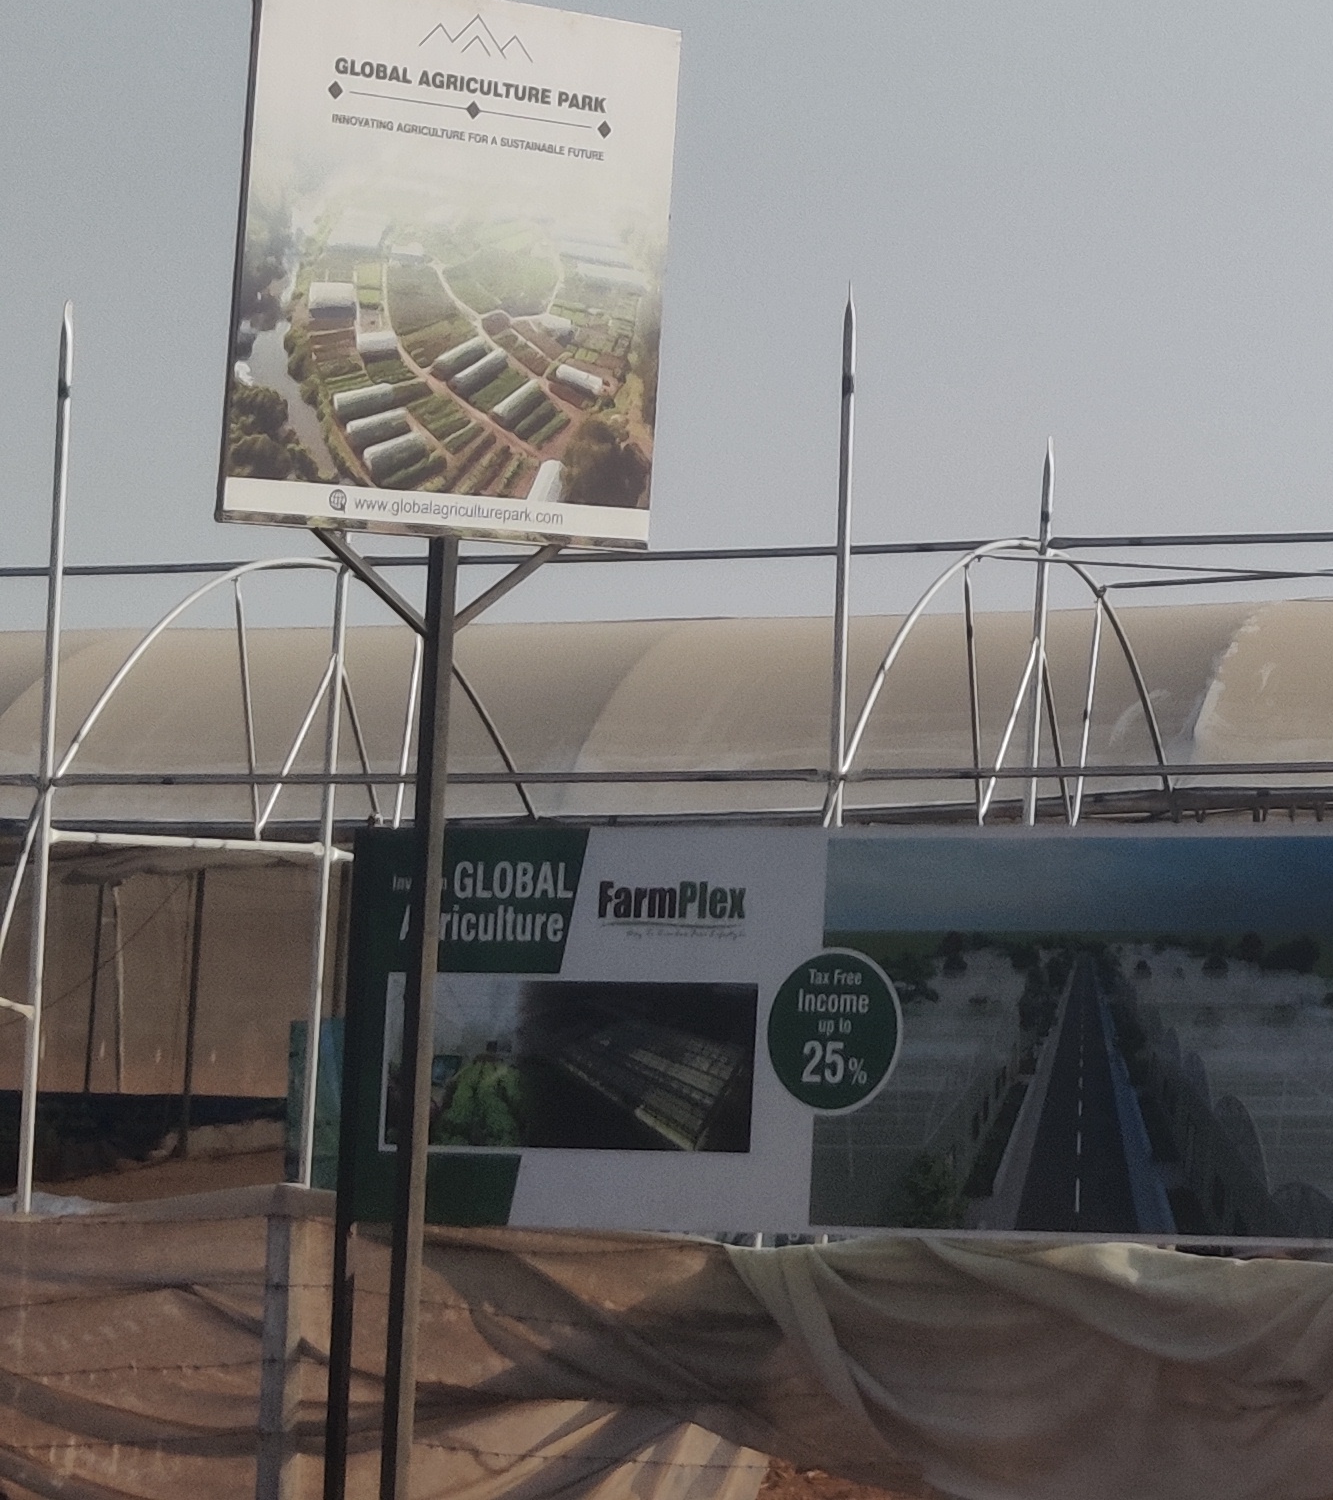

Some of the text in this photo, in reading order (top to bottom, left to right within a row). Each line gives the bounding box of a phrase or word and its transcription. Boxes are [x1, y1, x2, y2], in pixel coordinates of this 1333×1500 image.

[334, 57, 606, 114] GLOBAL AGRICULTURE PARK
[332, 113, 605, 161] INNOVATING AGRICULTURE FOR A SUSTAINABLE FUTURE
[354, 497, 563, 525] www.globalagriculturepark.com
[454, 861, 574, 899] GLOBAL
[598, 880, 747, 919] FarmPlex
[400, 904, 564, 942] riculture
[808, 968, 862, 986] Tax Free
[798, 988, 869, 1014] Income
[818, 1017, 853, 1036] up to
